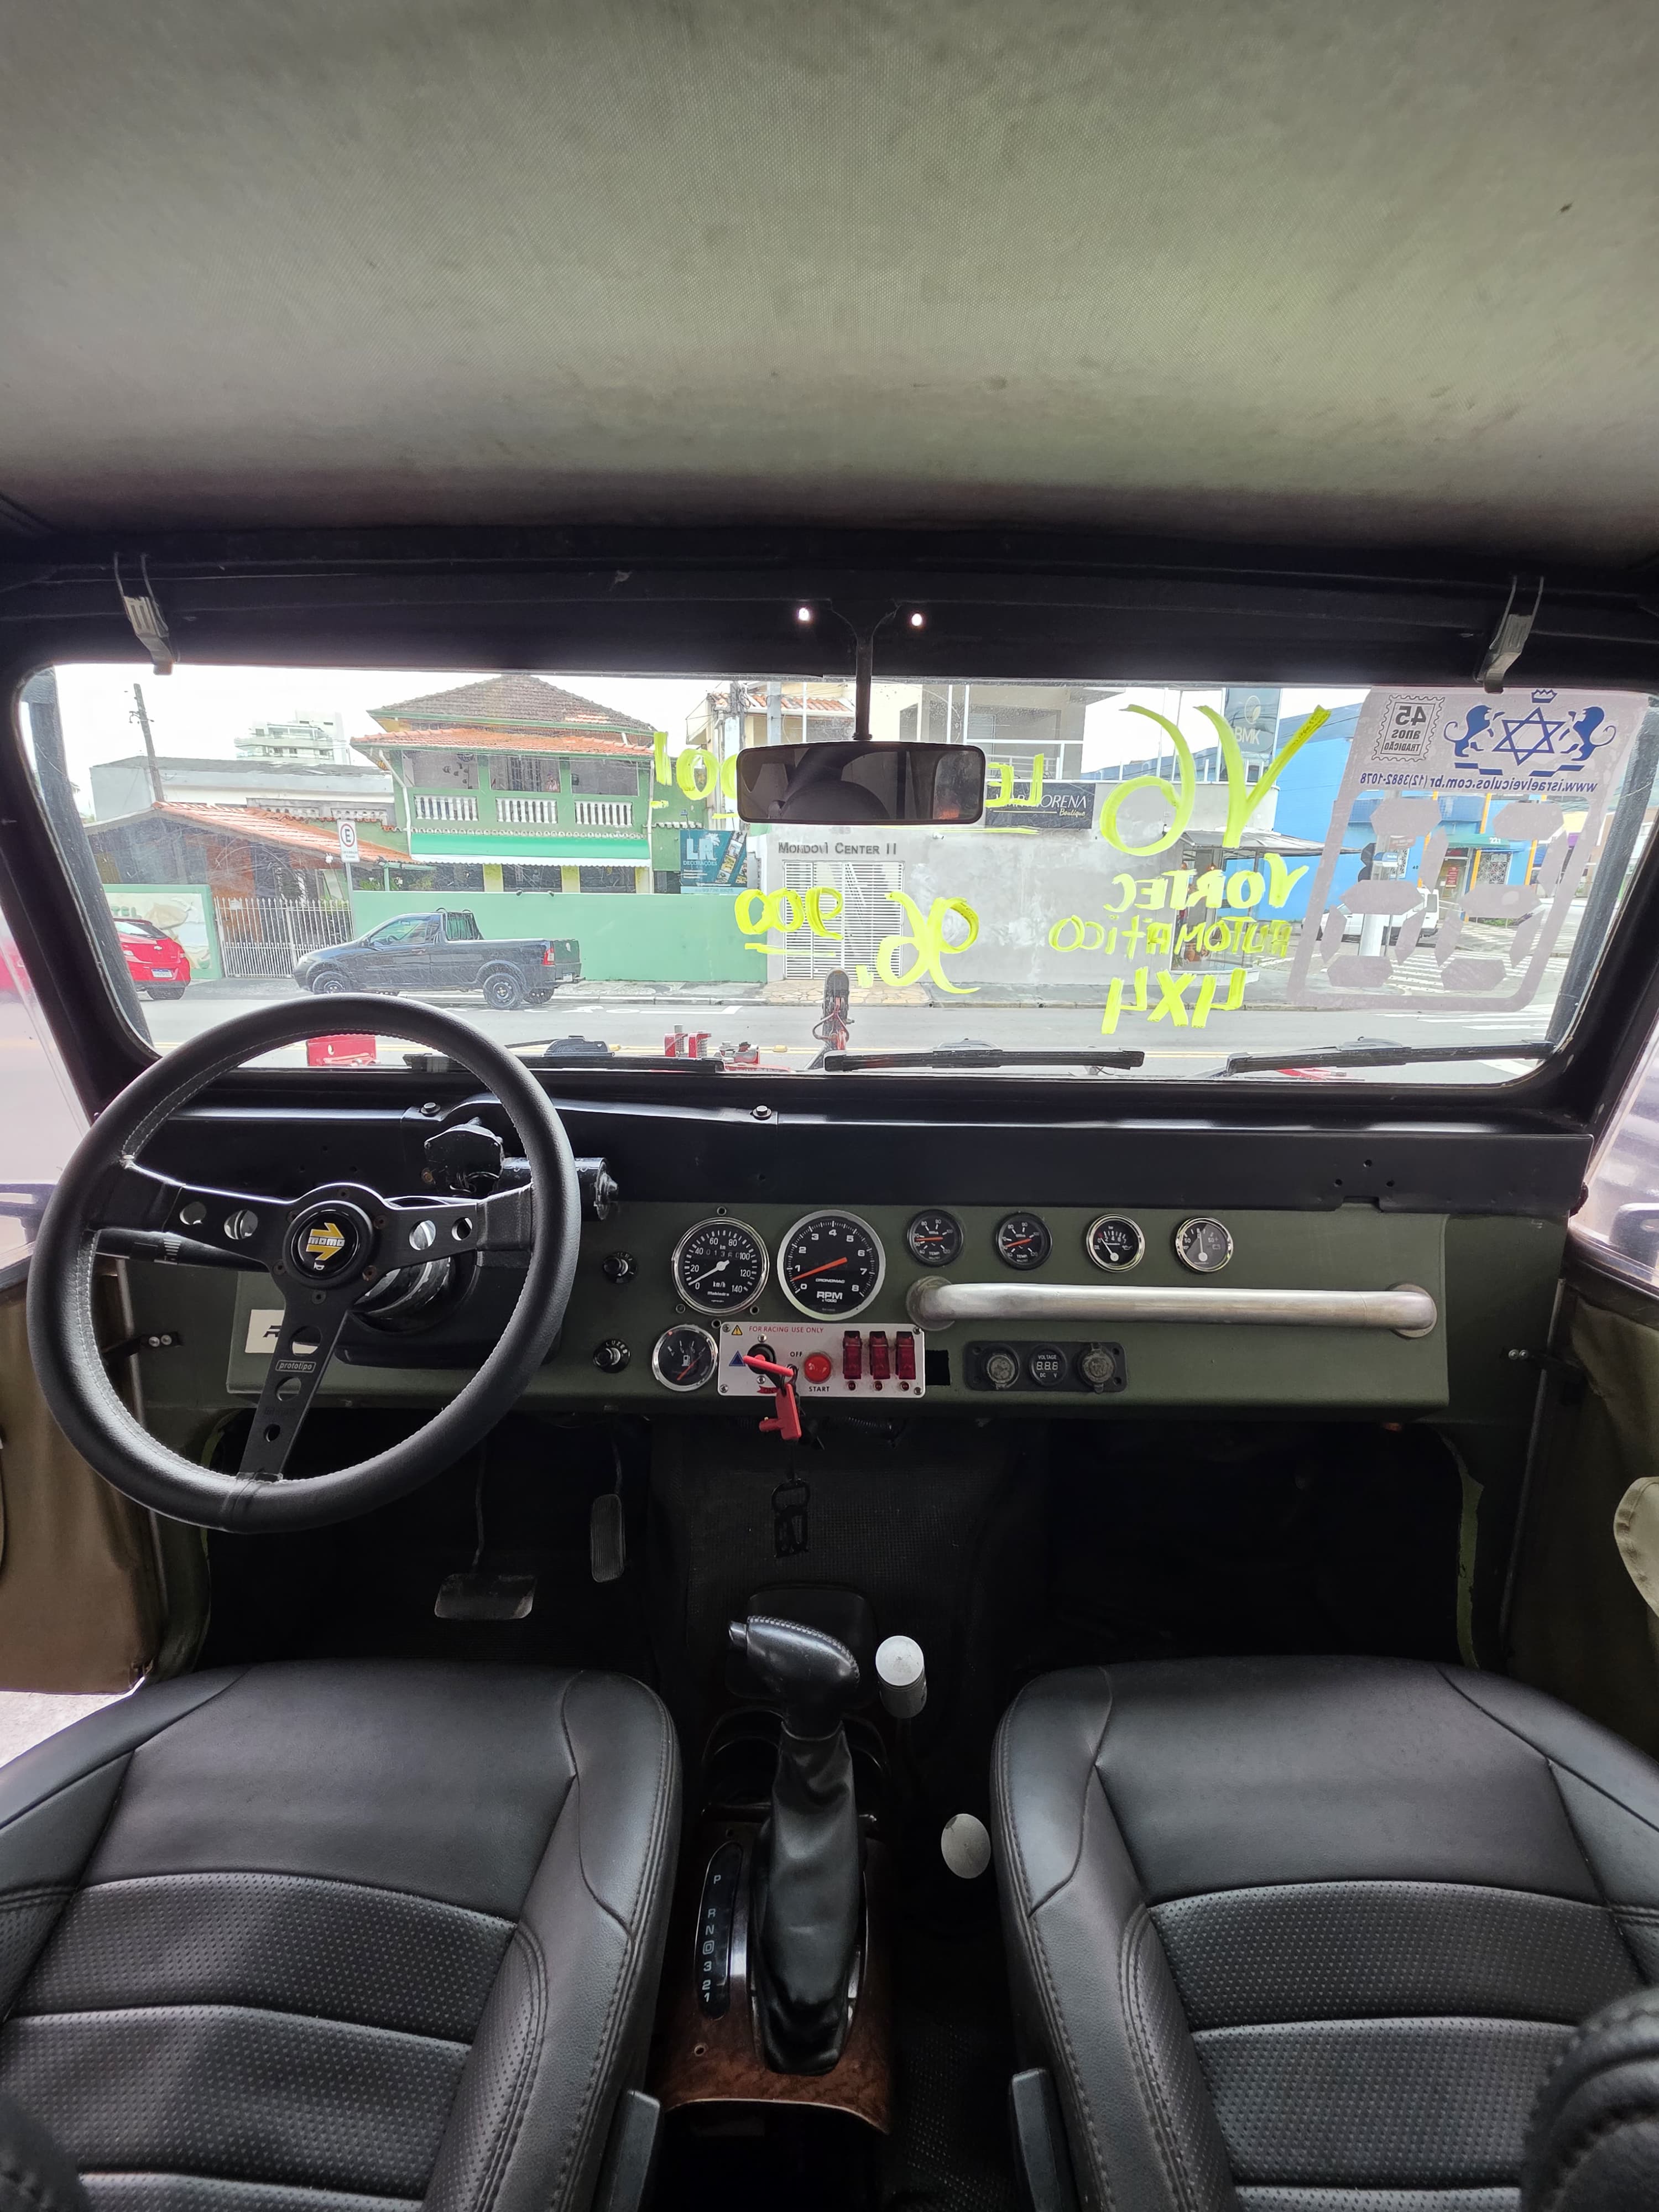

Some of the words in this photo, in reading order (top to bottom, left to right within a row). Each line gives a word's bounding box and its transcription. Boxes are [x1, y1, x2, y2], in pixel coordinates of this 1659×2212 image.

[1234, 726, 1260, 745] BMK
[345, 828, 351, 842] E
[835, 842, 880, 854] CENTER
[817, 1291, 843, 1300] RPM
[279, 1363, 312, 1371] prototipo
[713, 1875, 721, 1884] P
[708, 1908, 716, 1918] R
[706, 1925, 714, 1936] N
[703, 1961, 712, 1971] 3
[702, 1979, 711, 1990] 2
[704, 1992, 710, 2002] 1
